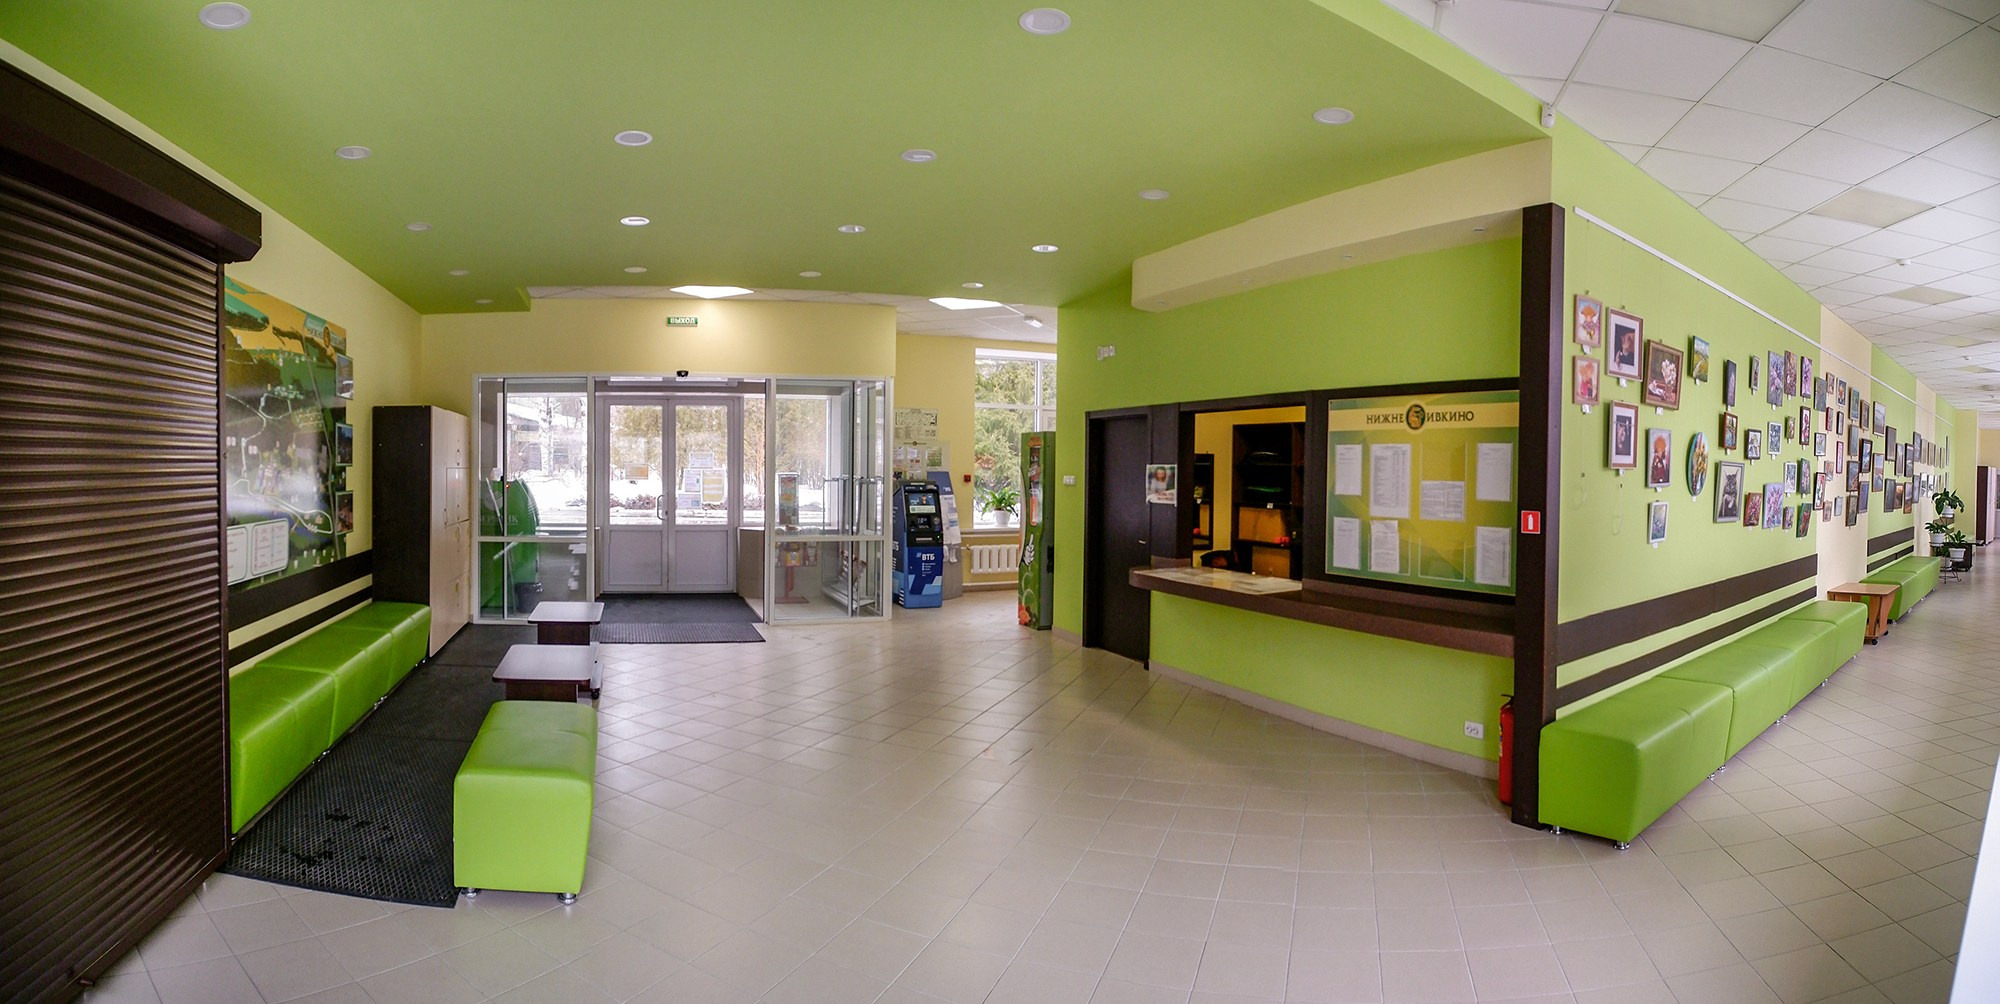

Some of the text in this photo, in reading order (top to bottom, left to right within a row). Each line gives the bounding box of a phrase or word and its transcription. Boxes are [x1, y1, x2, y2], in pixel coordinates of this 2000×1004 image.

[1366, 411, 1475, 424] НИЖНЕ ИВКИНО
[921, 553, 936, 561] ВТБ
